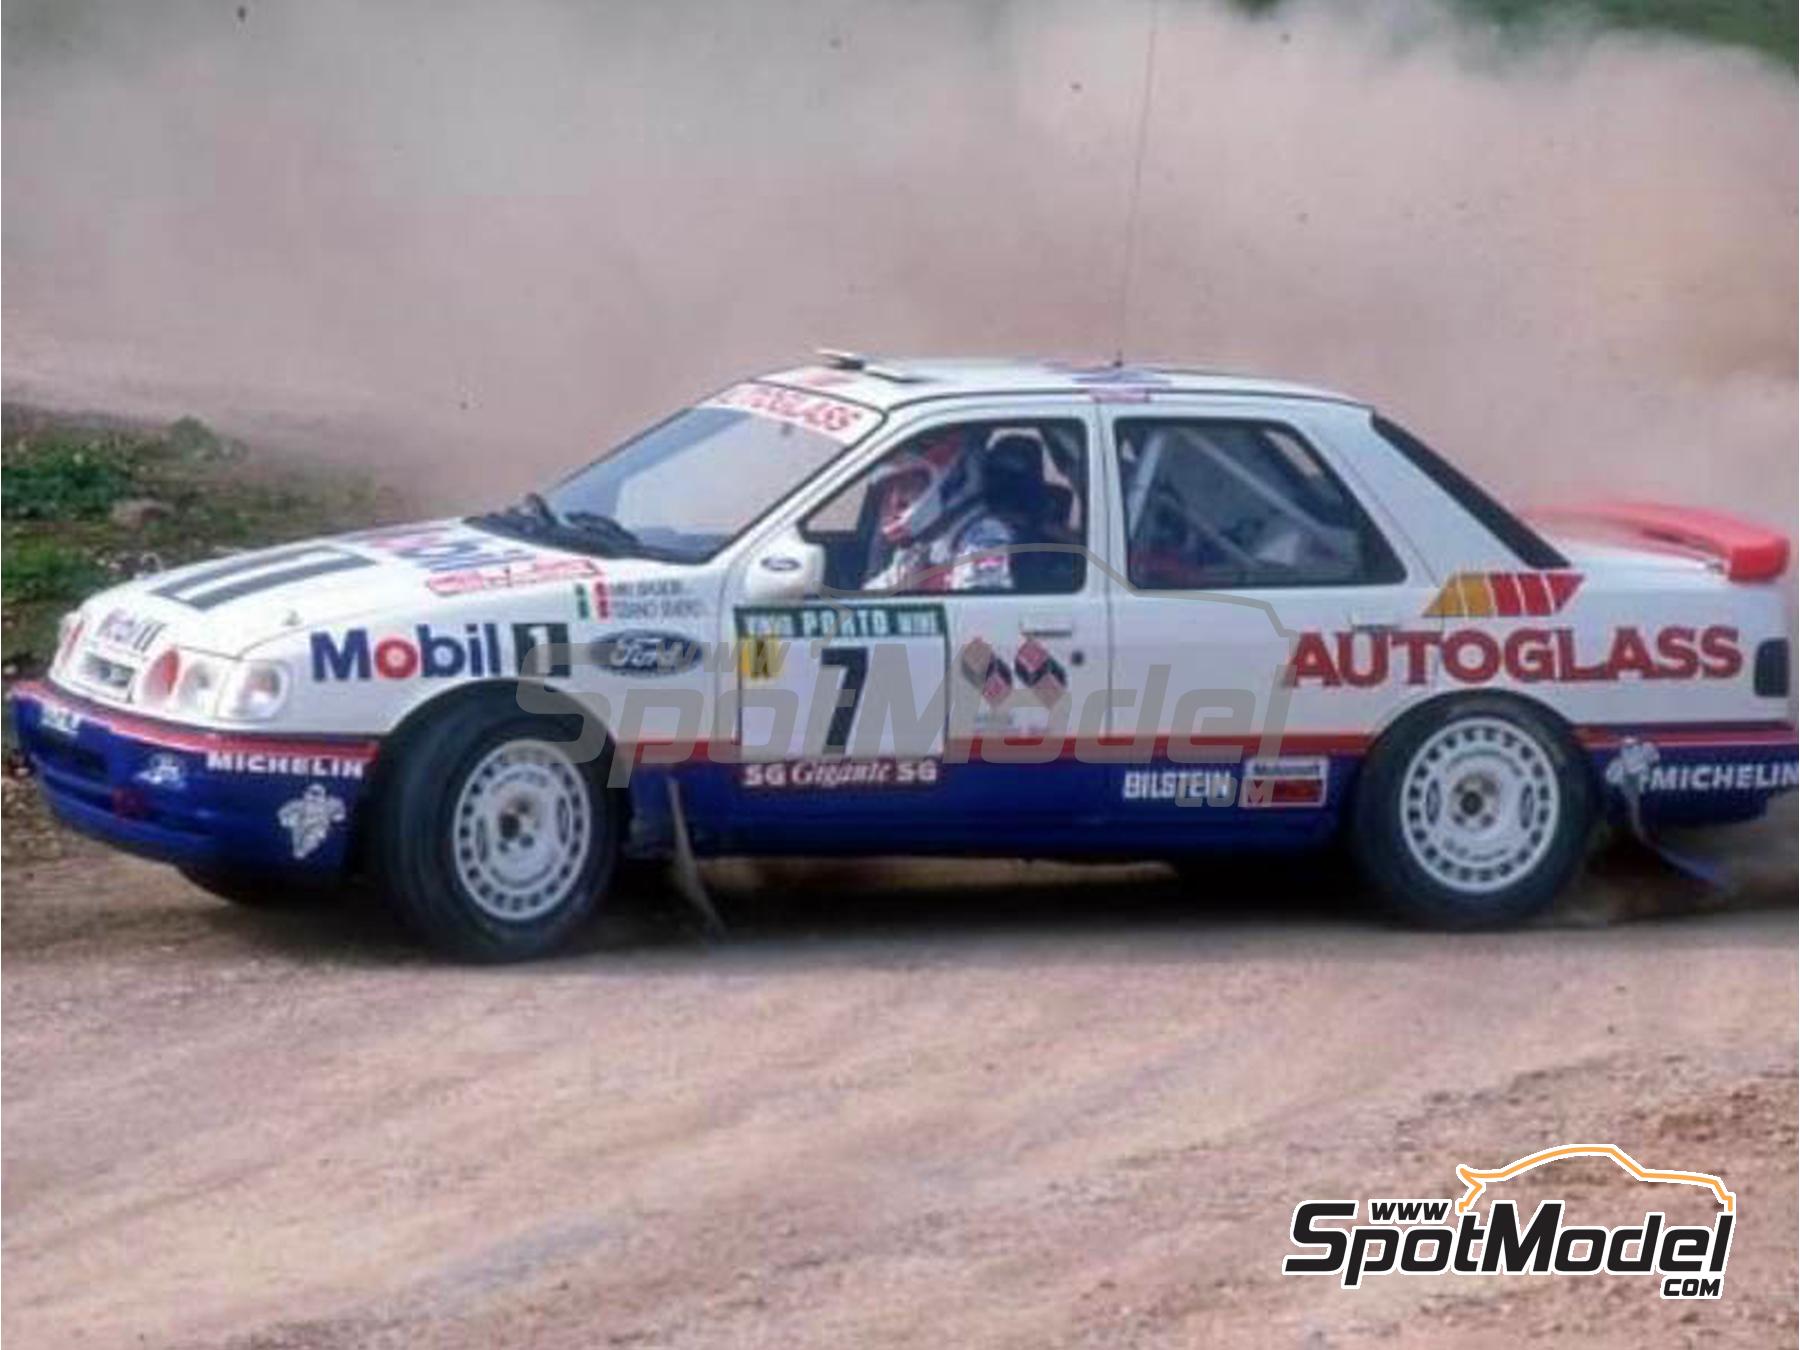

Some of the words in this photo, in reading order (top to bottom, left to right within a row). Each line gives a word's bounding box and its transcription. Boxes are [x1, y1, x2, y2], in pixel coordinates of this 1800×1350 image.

[311, 623, 500, 681] Mobil
[1284, 625, 1744, 687] AUTOGLASS
[820, 647, 869, 755] 7
[207, 752, 364, 778] MICHELIN
[744, 764, 786, 786] SG
[898, 758, 937, 782] SG
[1650, 763, 1799, 790] MICHELIN
[1123, 771, 1231, 800] BILSTEIN
